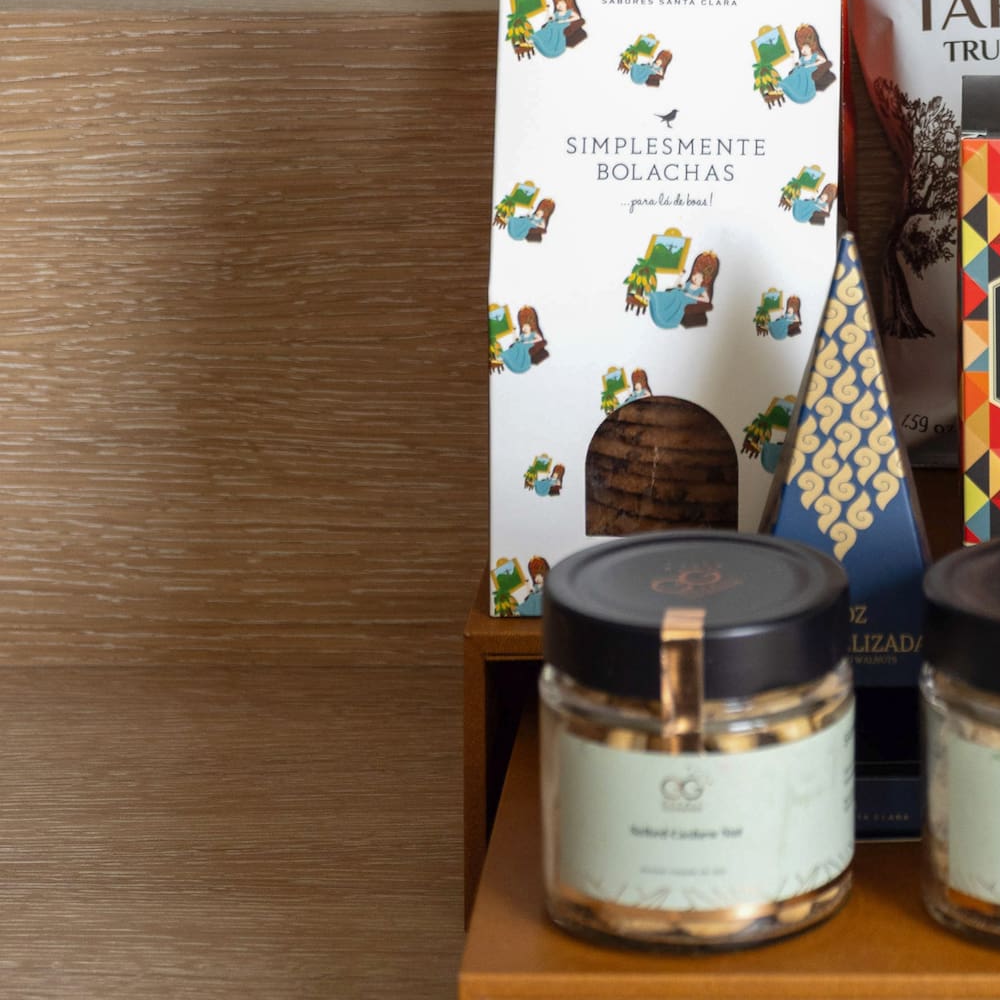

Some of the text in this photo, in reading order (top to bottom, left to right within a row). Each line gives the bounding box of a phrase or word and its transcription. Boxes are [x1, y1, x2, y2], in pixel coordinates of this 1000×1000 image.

[701, 0, 738, 7] CLARA
[566, 136, 766, 156] SIMPLESMENTE
[597, 163, 735, 182] BOLACHAS
